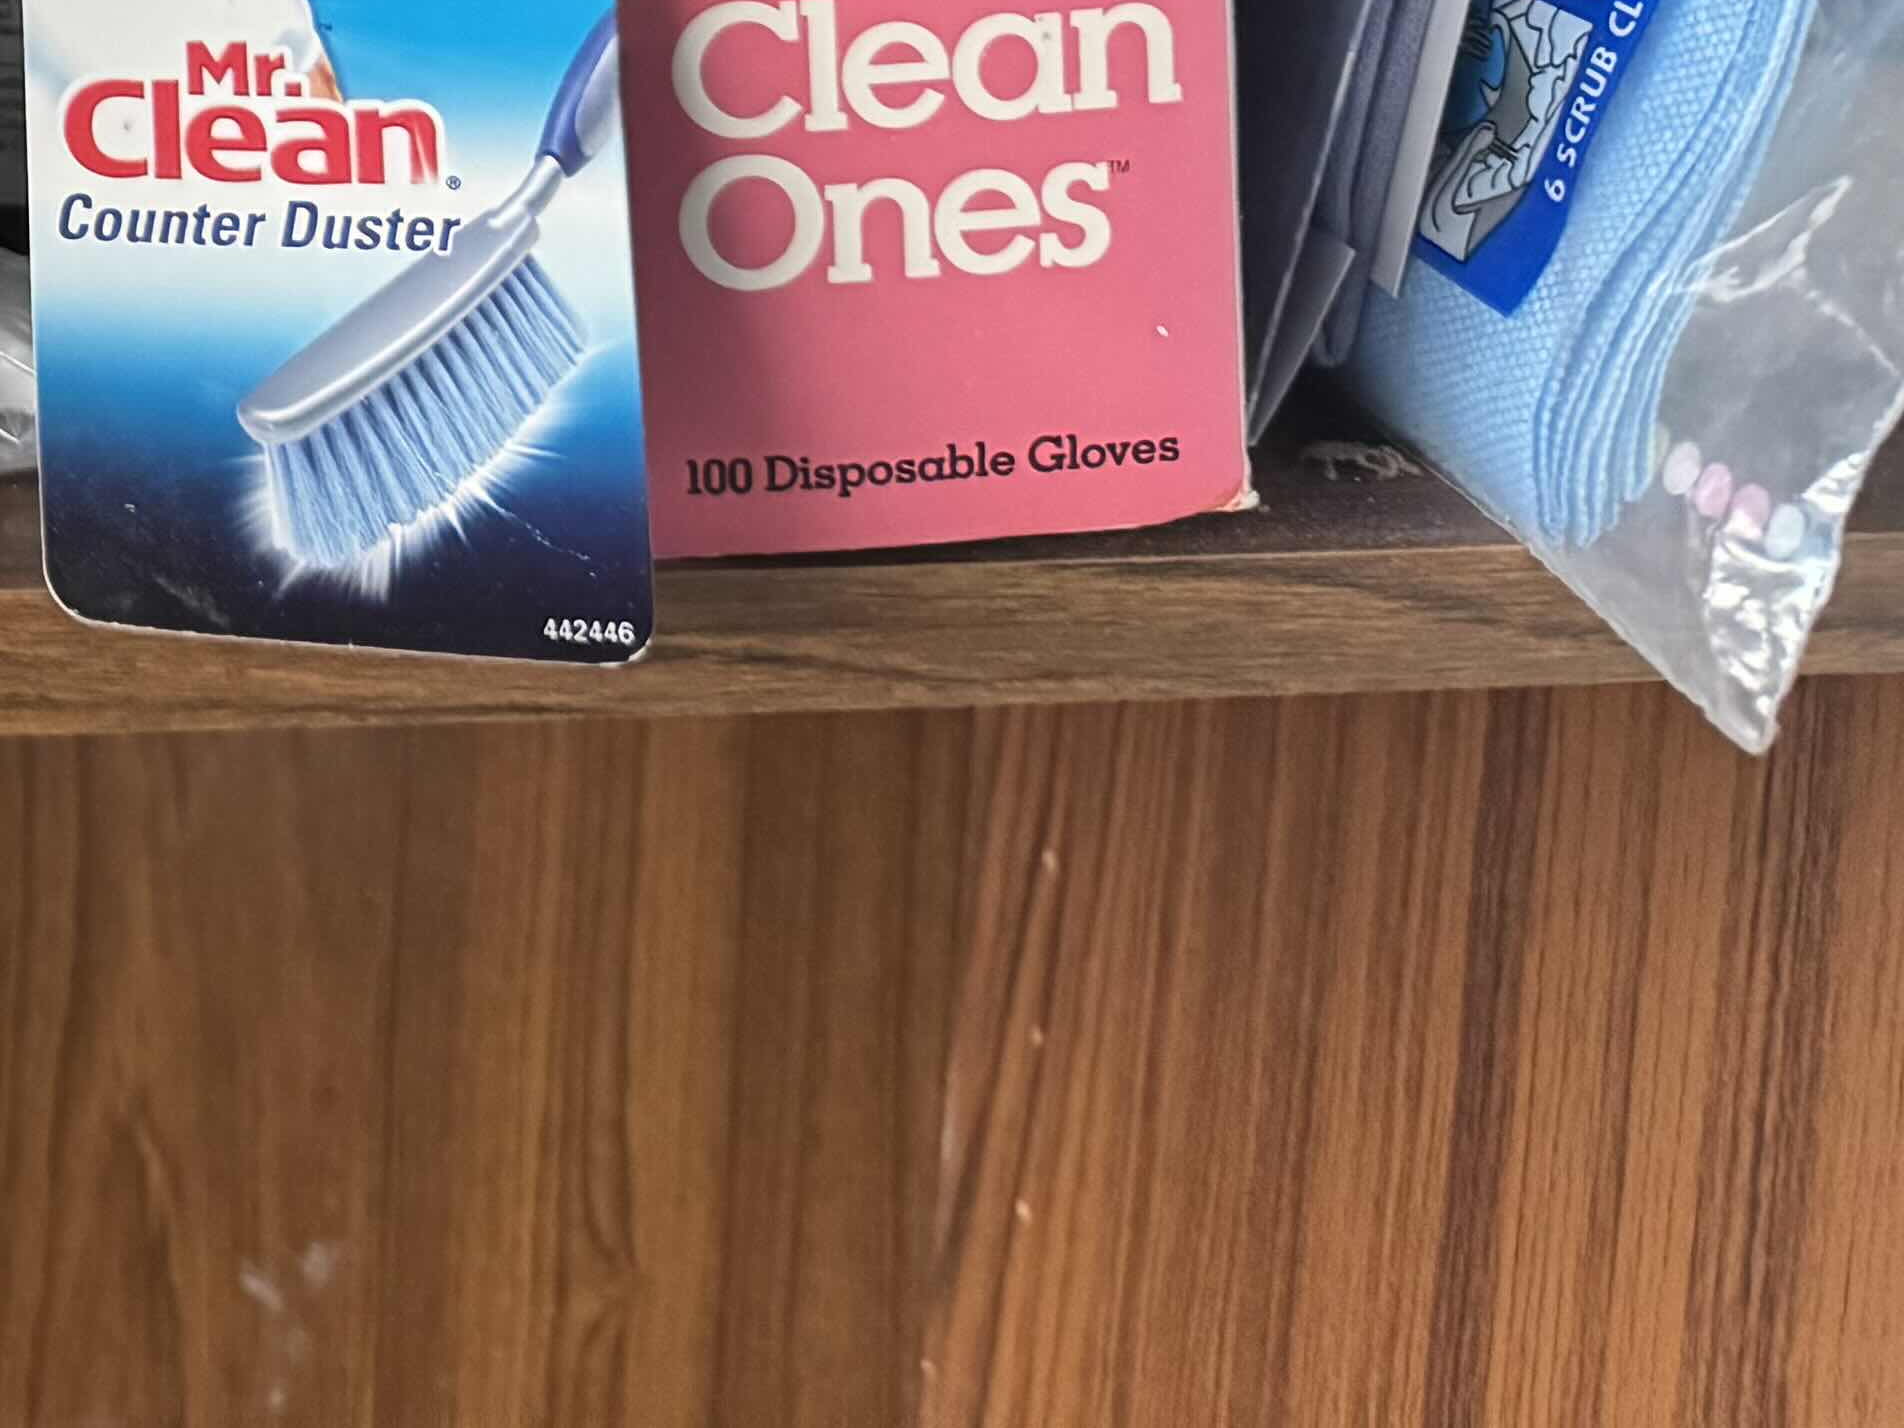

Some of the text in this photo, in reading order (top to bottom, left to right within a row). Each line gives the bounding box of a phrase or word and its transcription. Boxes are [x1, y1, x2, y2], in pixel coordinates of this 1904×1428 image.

[187, 42, 300, 97] Mr.
[64, 79, 439, 185] Clean
[1545, 177, 1566, 203] 6
[1557, 46, 1618, 168] SCRUB
[58, 193, 460, 251] Counter Duster
[679, 155, 1112, 291] Ones
[686, 432, 1181, 498] 100 Disposable Gloves
[542, 617, 634, 644] 442446
